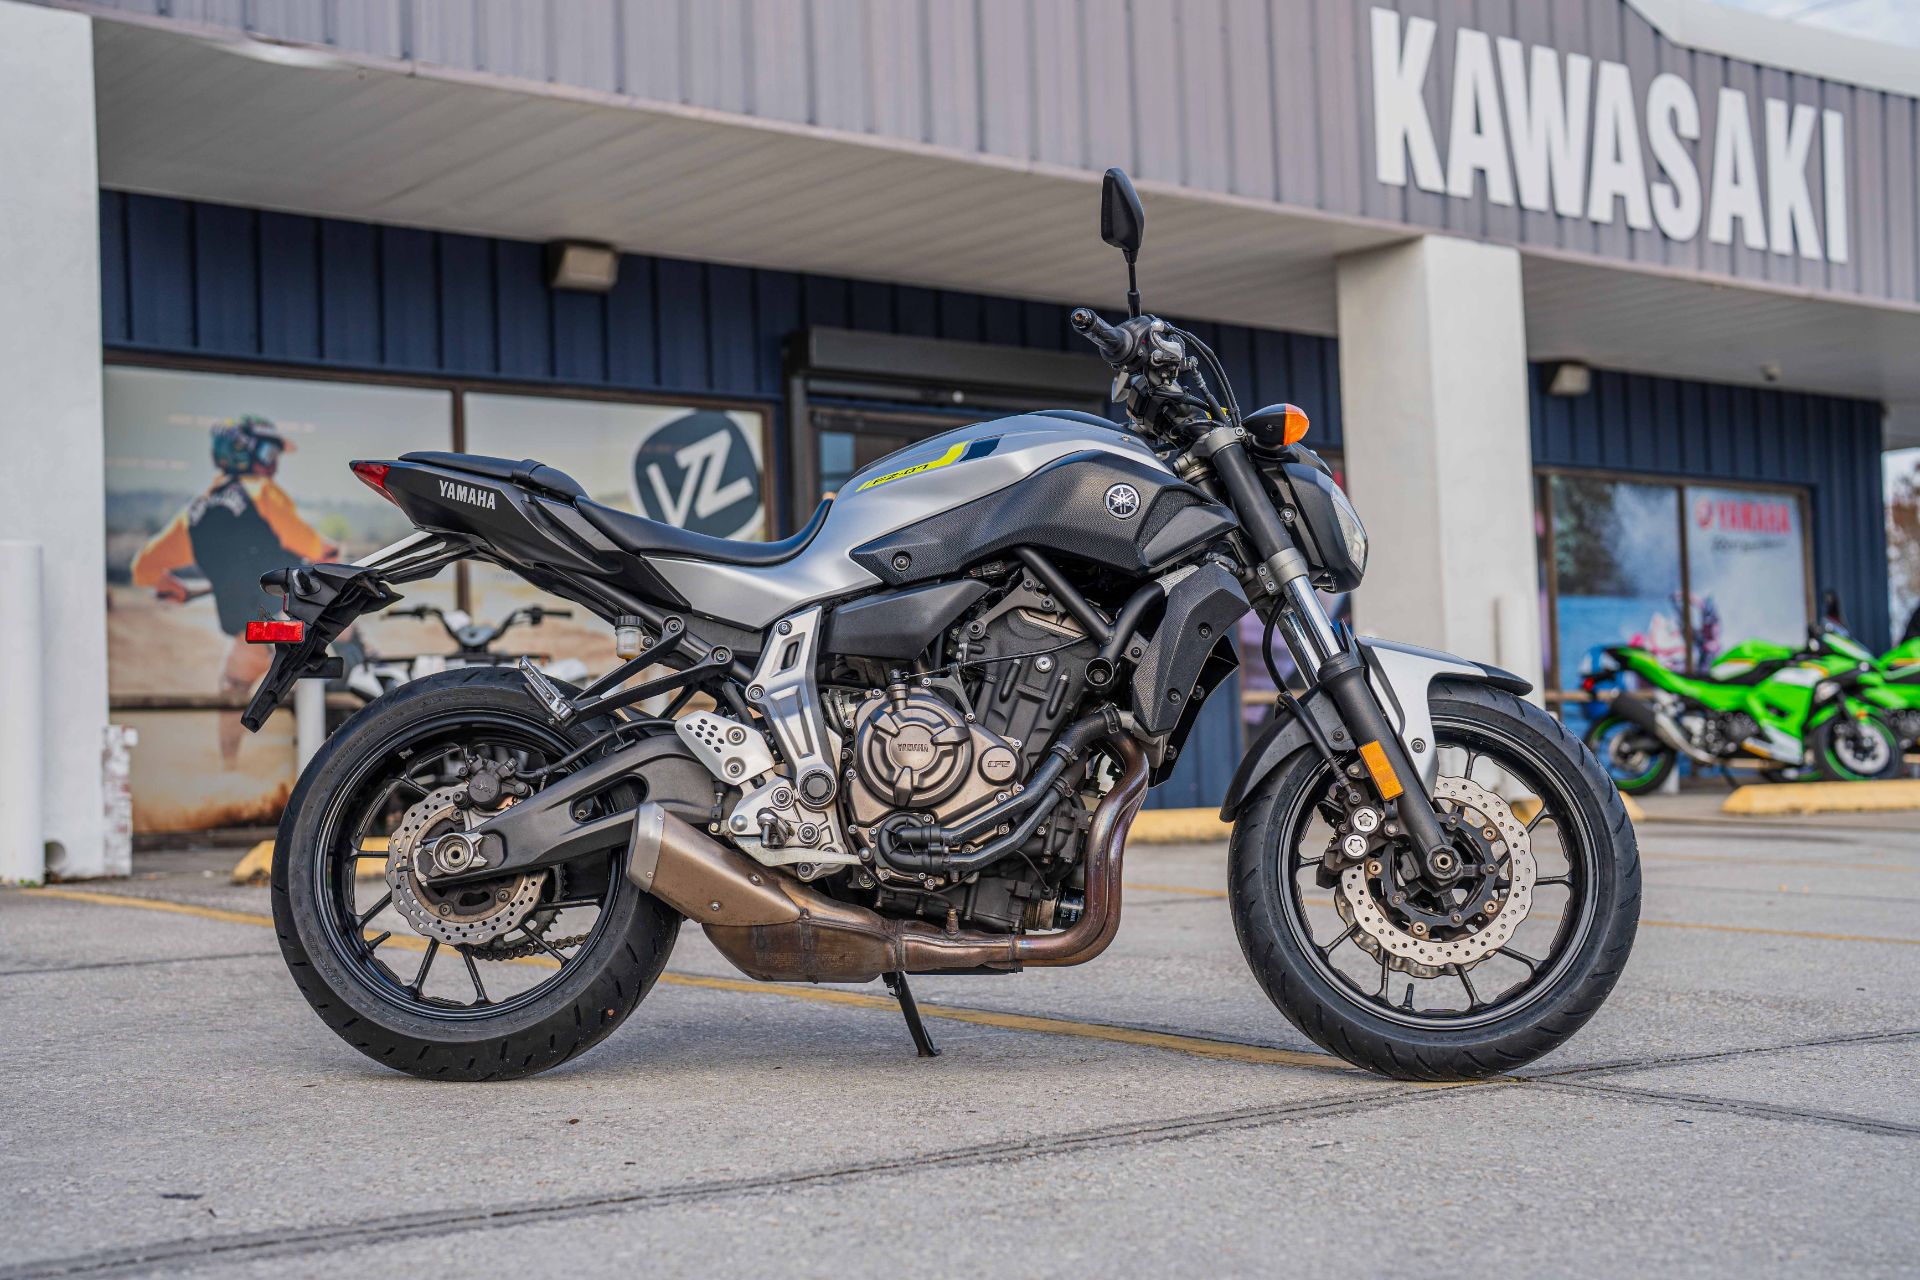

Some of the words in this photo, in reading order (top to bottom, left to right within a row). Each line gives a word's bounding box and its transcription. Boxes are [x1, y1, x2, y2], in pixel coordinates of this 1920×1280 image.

[1370, 7, 1848, 264] KAWASAKI
[439, 479, 496, 510] YAMAHA
[1716, 500, 1792, 534] YAMAHA
[897, 743, 929, 753] YAMAHA
